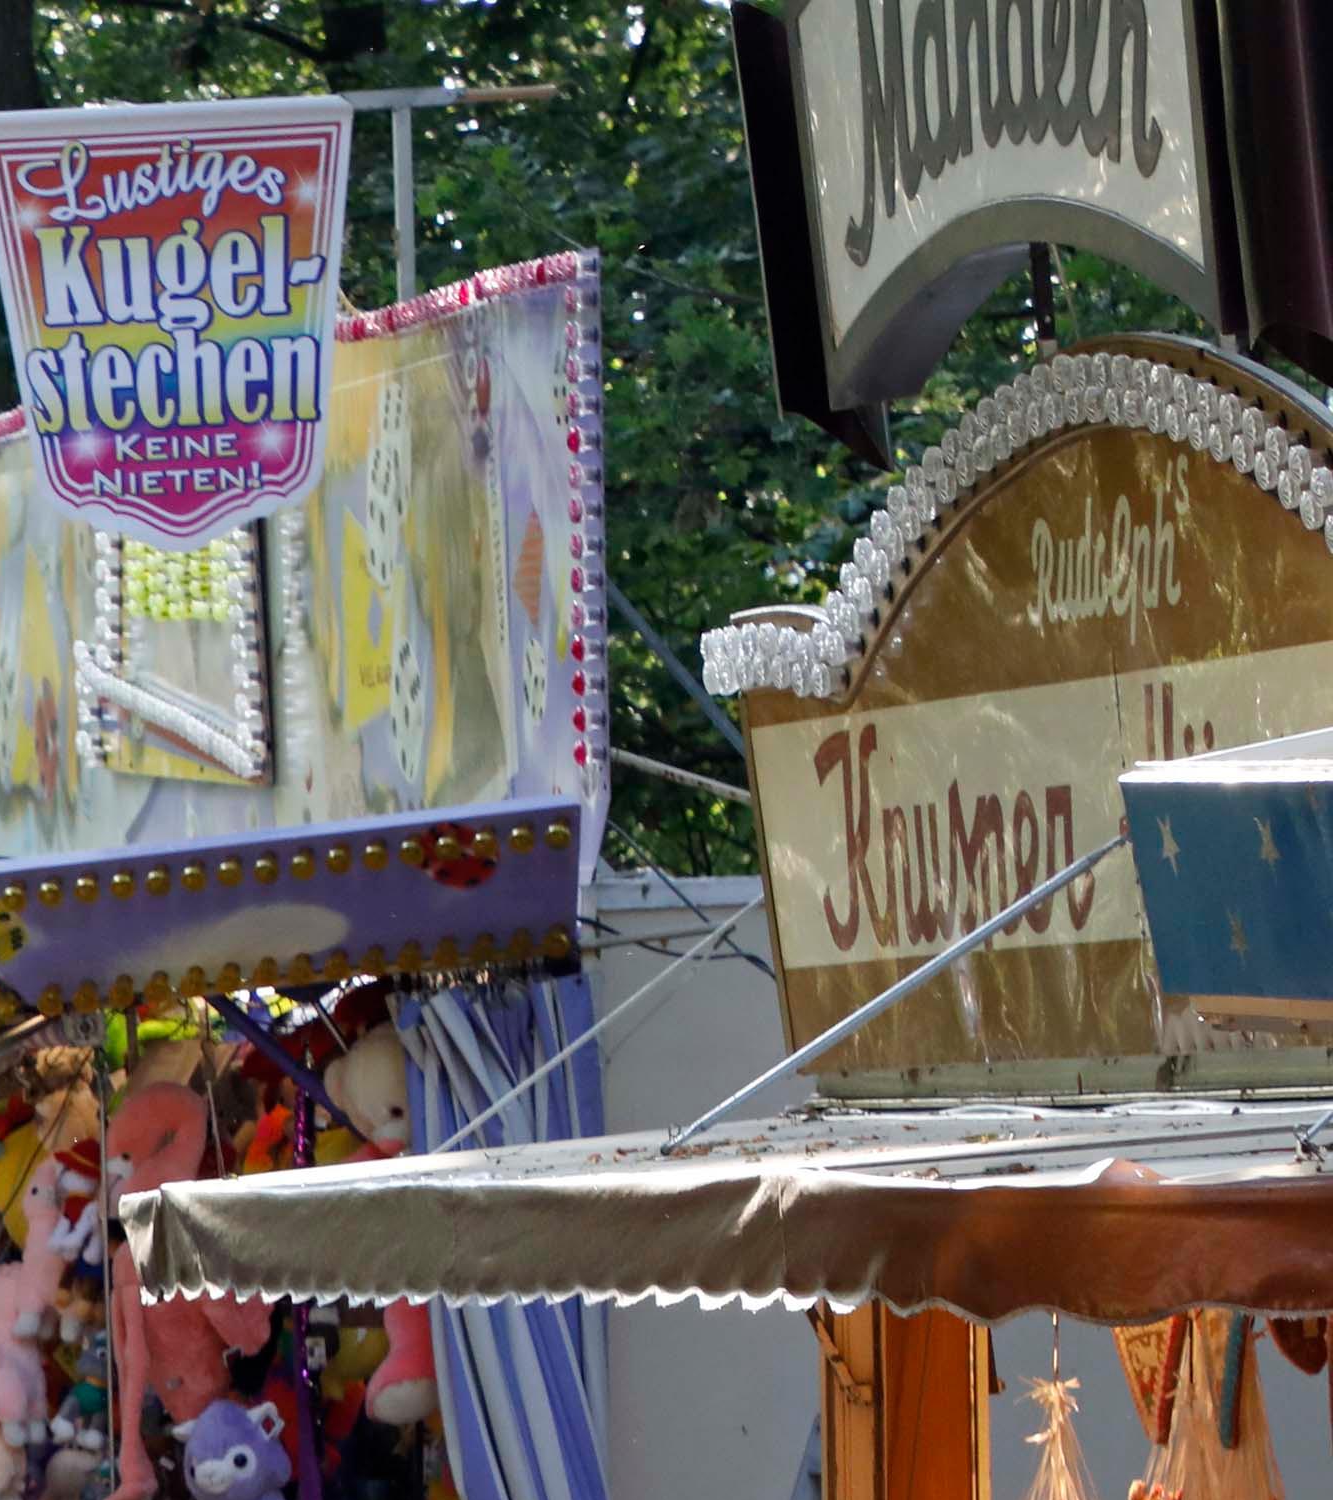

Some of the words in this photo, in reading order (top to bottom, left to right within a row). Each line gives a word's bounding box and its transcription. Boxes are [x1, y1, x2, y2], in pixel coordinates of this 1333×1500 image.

[16, 137, 286, 222] Lustiges
[34, 213, 326, 334] Kugel-
[25, 326, 323, 434] stechen
[93, 461, 263, 496] NIETEN!
[115, 432, 239, 464] KEINE
